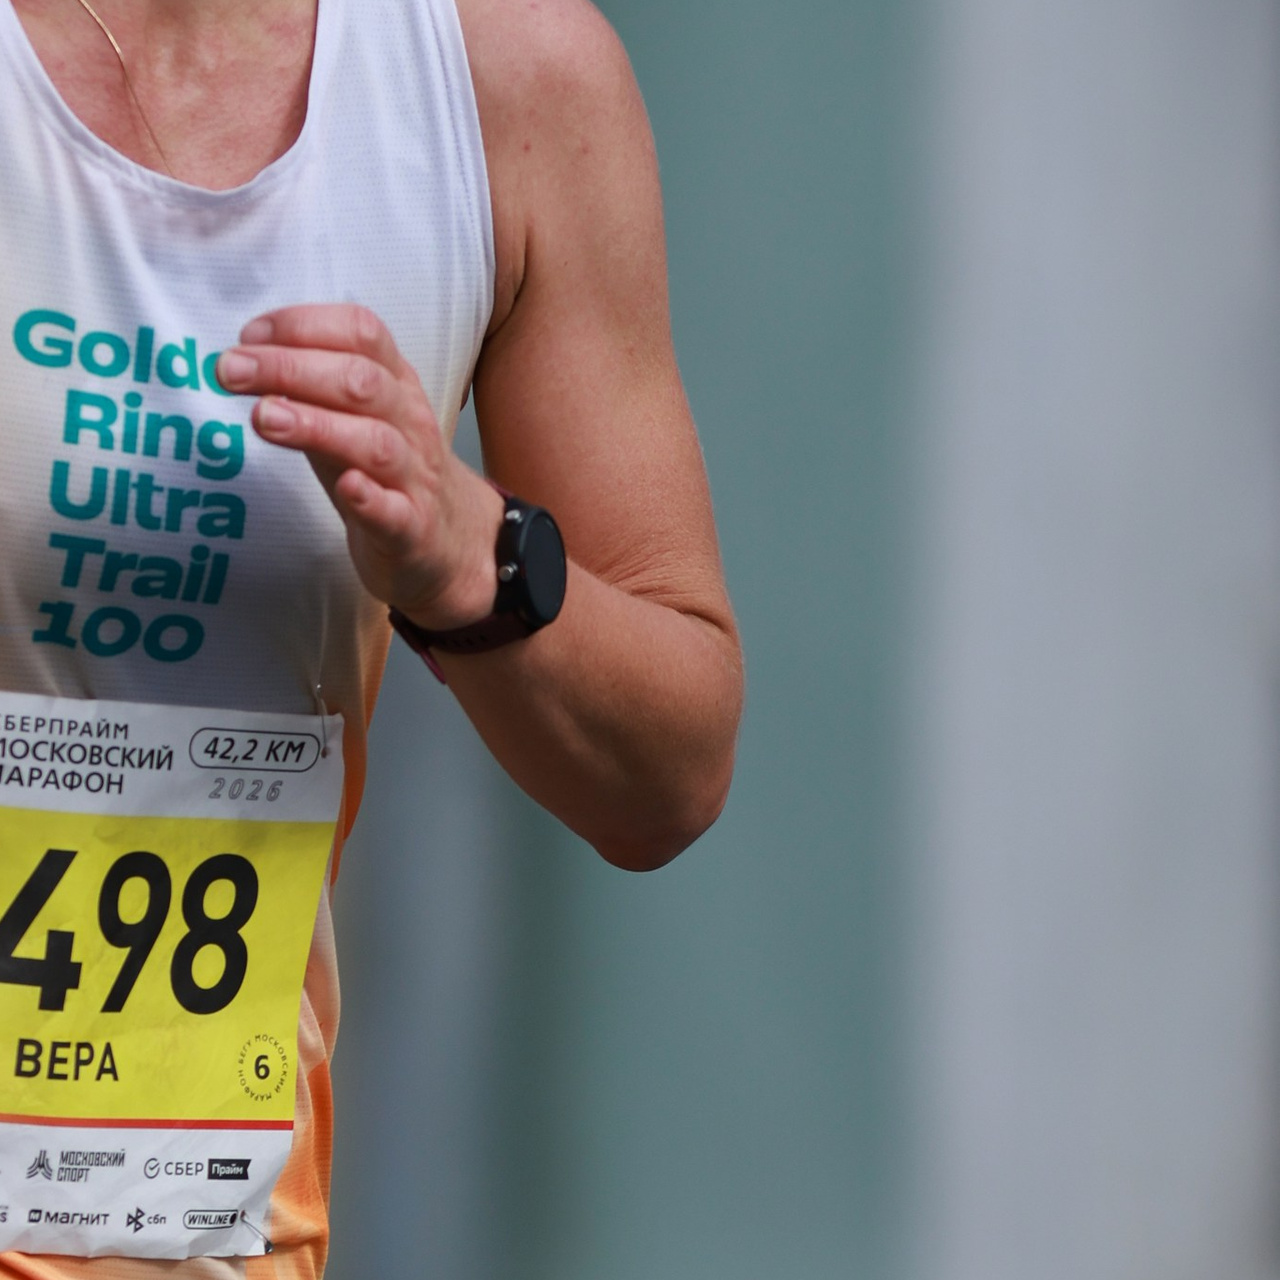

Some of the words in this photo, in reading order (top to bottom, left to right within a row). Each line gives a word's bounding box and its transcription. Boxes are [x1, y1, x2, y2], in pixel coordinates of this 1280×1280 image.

[63, 389, 245, 481] Ring
[49, 460, 247, 540] Ultra
[49, 532, 230, 605] Trail
[31, 601, 206, 663] 100
[203, 736, 258, 764] 42,2
[208, 777, 283, 802] 2026
[14, 1038, 119, 1082] ВЕРА
[254, 1054, 270, 1080] 6
[60, 1148, 125, 1167] МОСКОВСКИЙ
[164, 1161, 204, 1176] СБЕР
[211, 1163, 244, 1177] Прайм
[57, 1167, 90, 1182] СПОРТ
[188, 1214, 230, 1225] WINLINE
